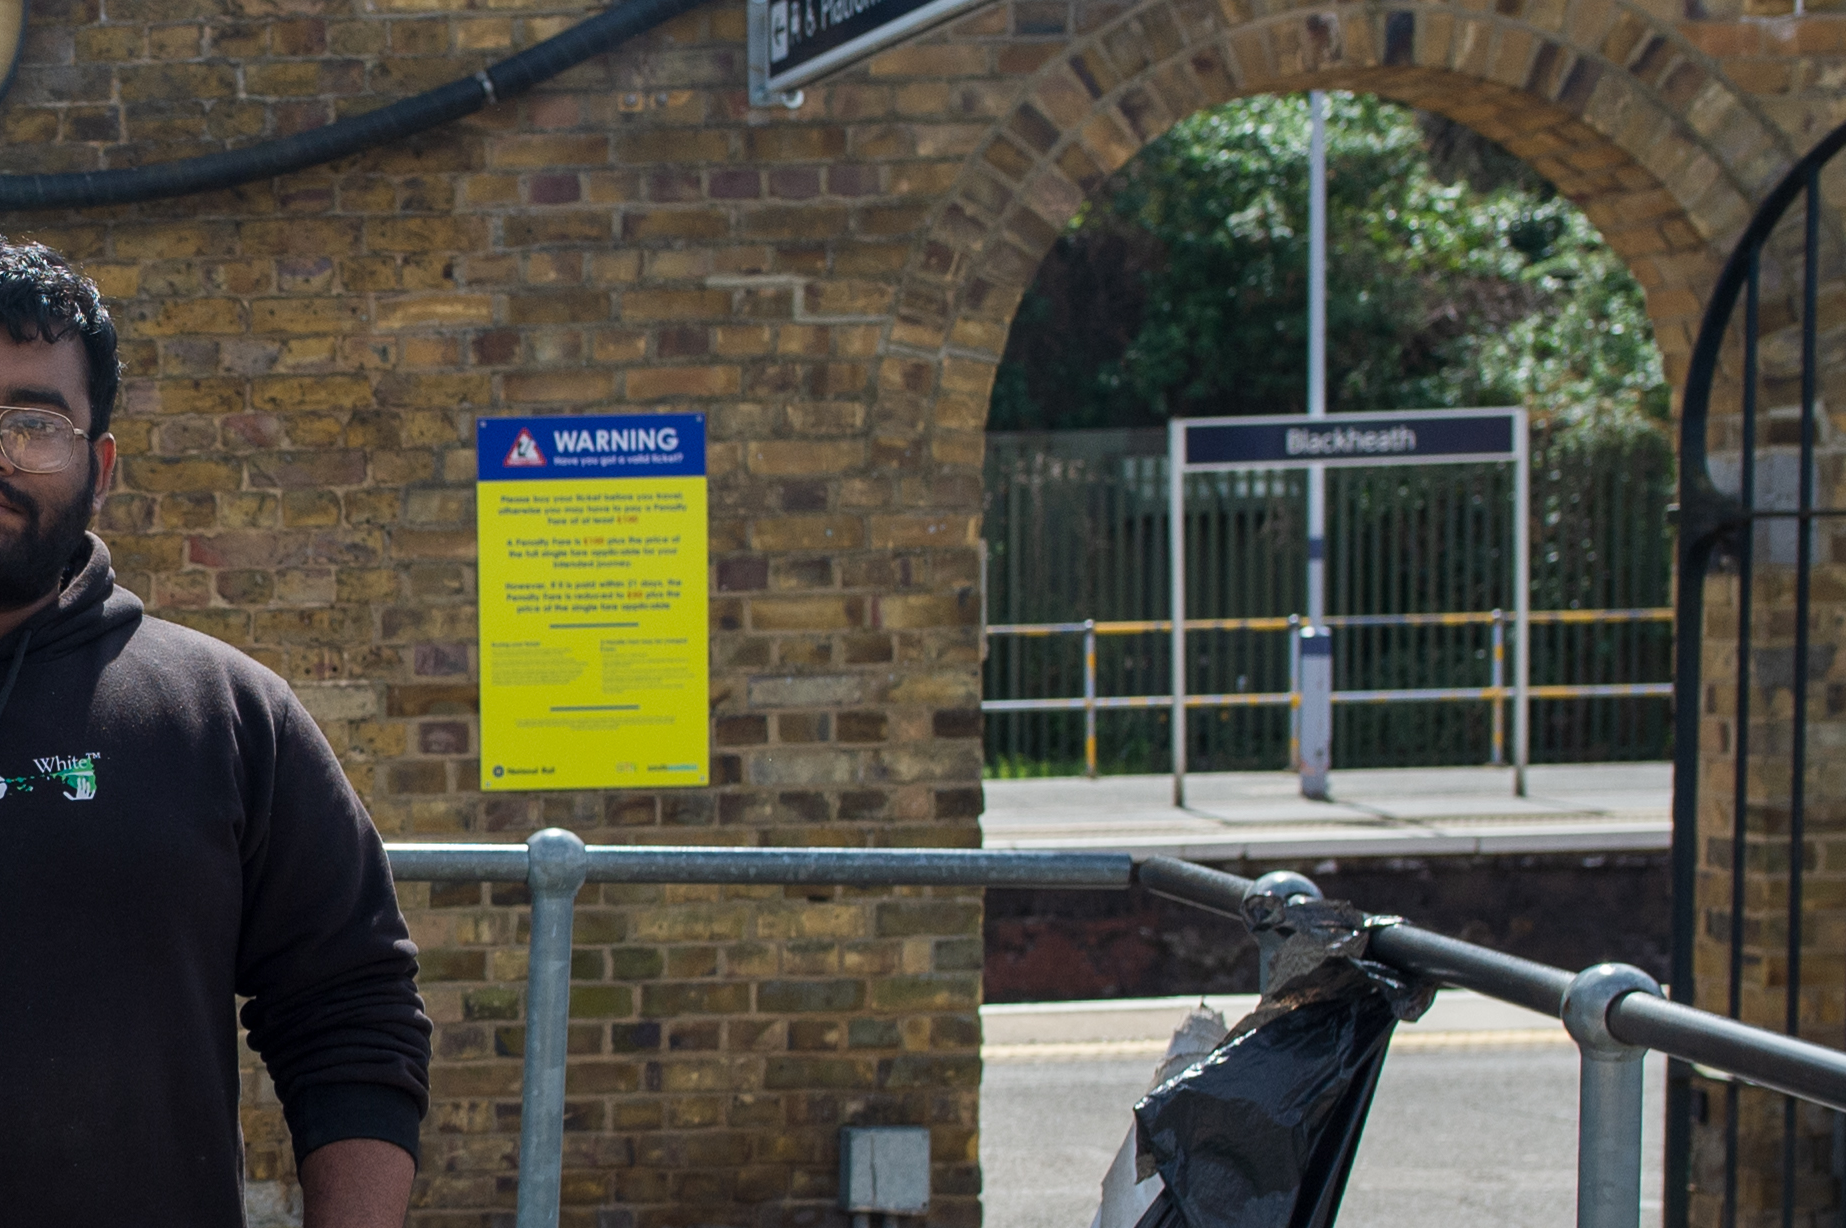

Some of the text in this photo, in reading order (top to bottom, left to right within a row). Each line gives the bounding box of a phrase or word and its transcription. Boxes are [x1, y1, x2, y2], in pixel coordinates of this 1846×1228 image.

[553, 427, 679, 453] WARNING
[1286, 424, 1416, 454] Blackheath
[580, 457, 598, 467] you
